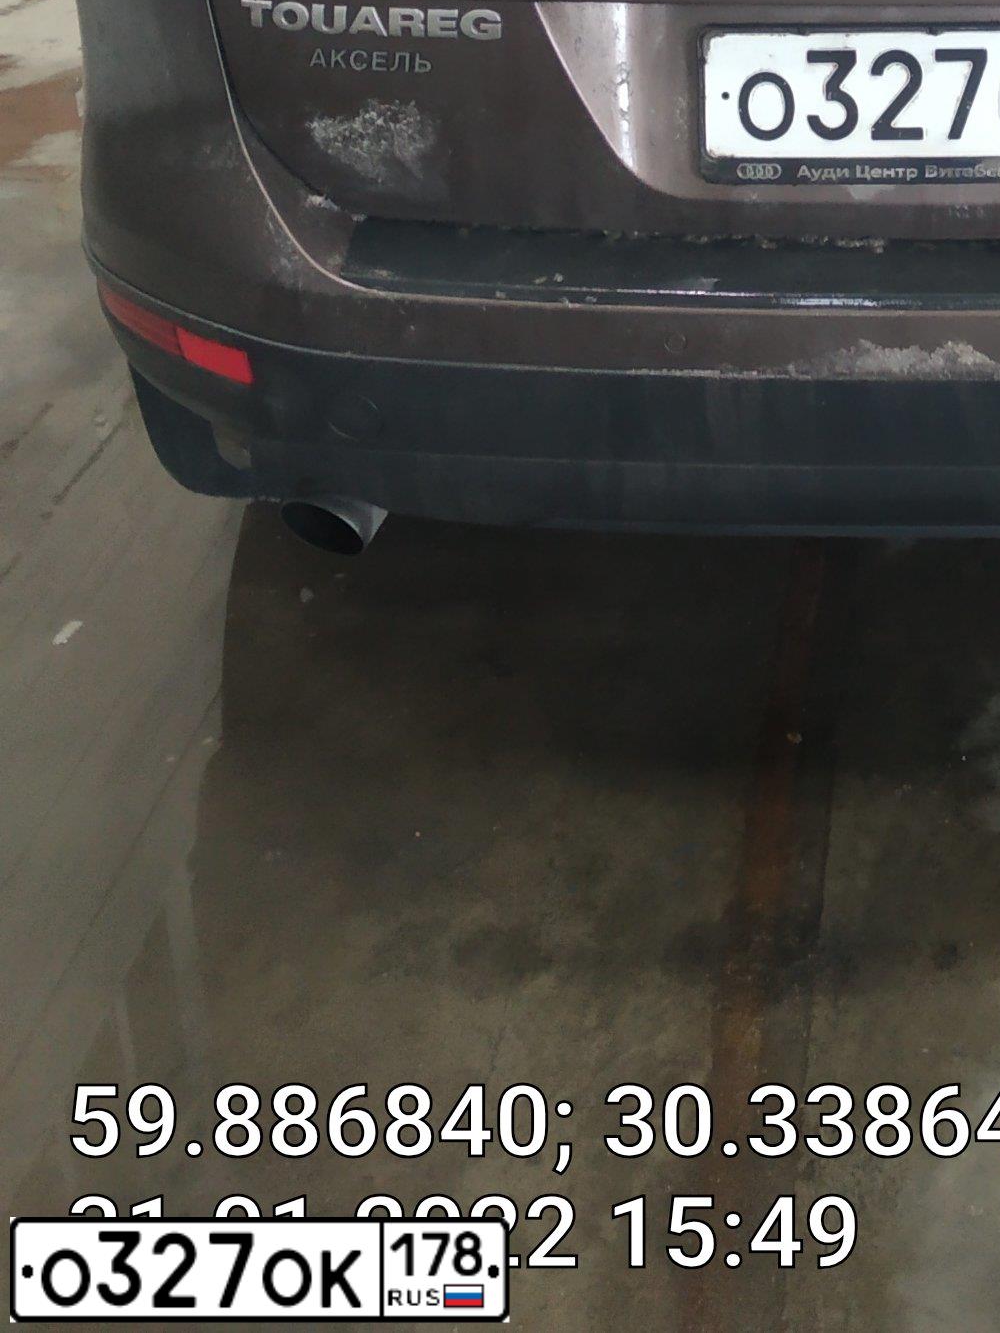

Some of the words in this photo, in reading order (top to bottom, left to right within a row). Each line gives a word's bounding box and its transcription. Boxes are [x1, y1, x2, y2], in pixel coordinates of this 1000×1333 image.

[309, 48, 432, 73] АКСЕЛЬ
[797, 164, 849, 181] Ауди
[856, 164, 918, 180] Центр
